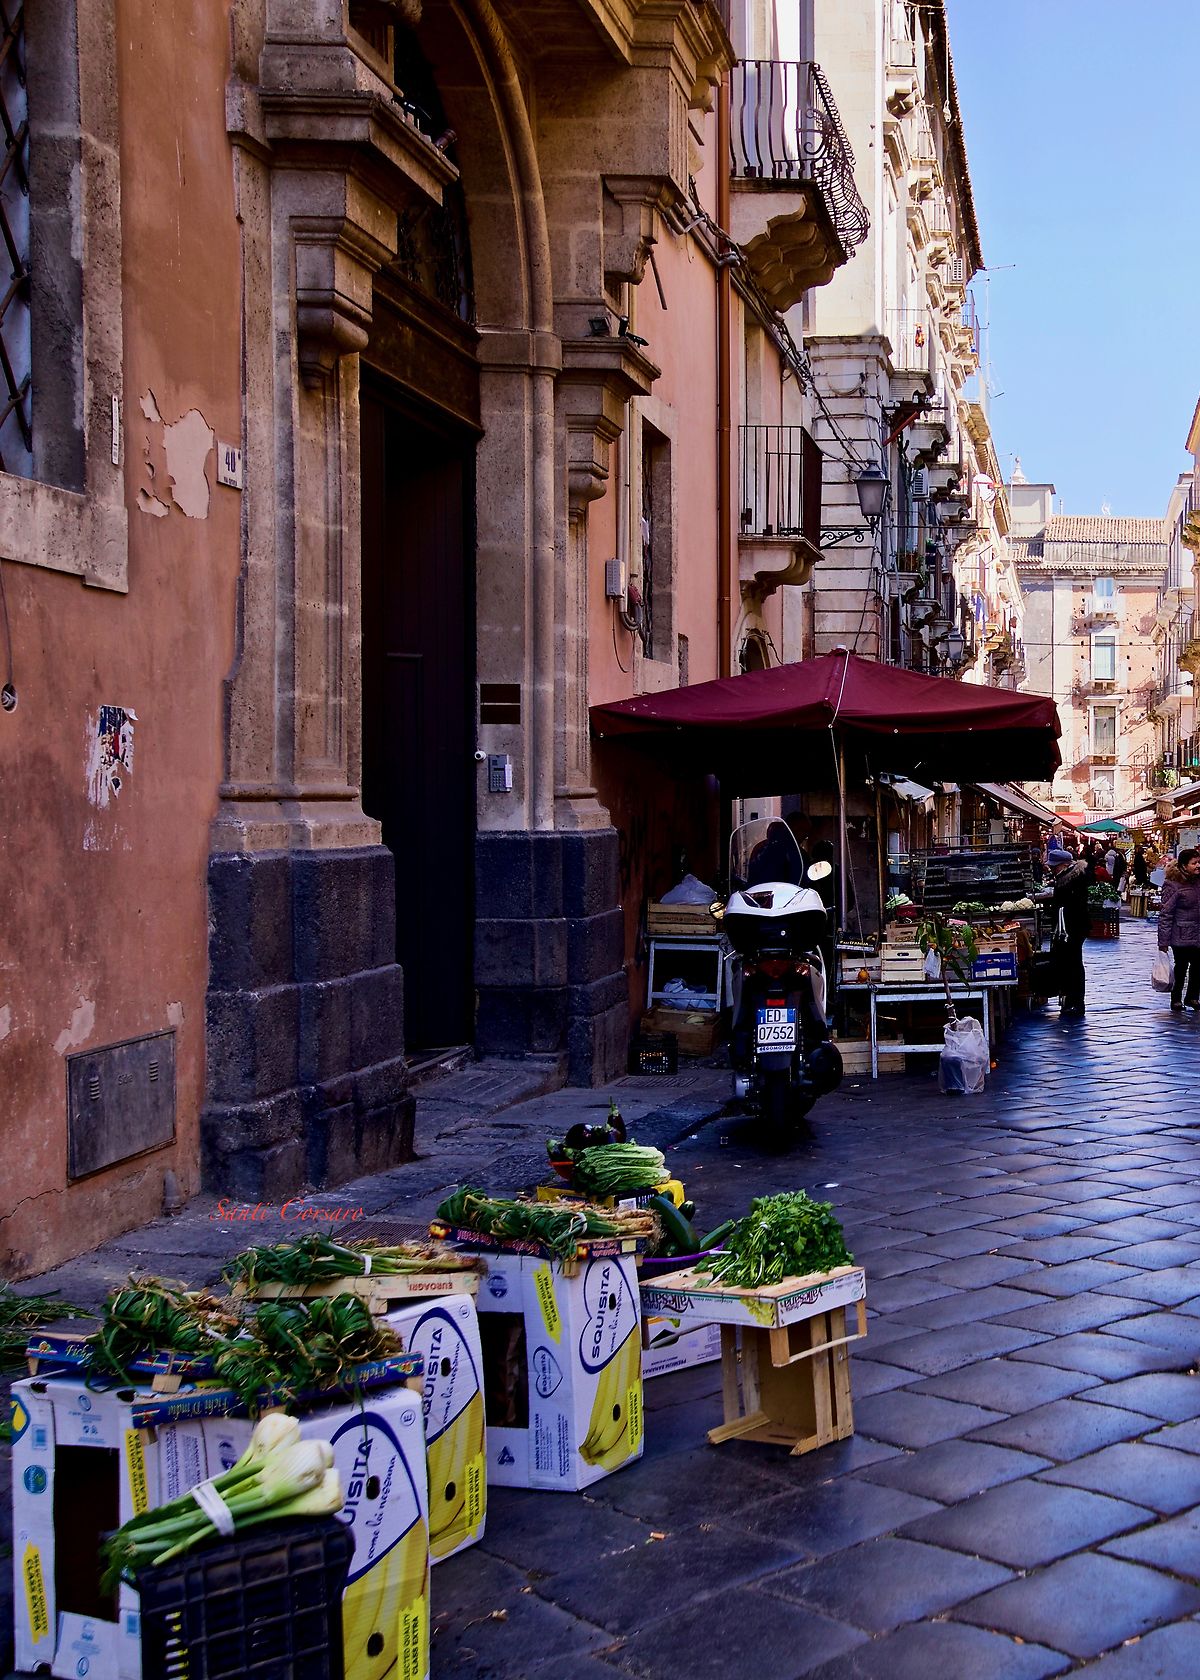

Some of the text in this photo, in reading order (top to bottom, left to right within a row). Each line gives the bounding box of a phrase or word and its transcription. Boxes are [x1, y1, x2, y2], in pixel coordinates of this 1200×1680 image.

[766, 1009, 781, 1023] ED
[759, 1026, 794, 1040] 07552
[408, 1282, 453, 1291] EUROAGRI
[782, 1287, 823, 1308] Vallesana
[592, 1266, 610, 1358] SQUISITA
[642, 1364, 665, 1376] BANANAS
[665, 1358, 687, 1370] PREMIUM
[346, 1437, 373, 1526] UISITA
[402, 1613, 411, 1680] ELECTED QUALITY
[411, 1615, 419, 1679] CLASS EXTRA
